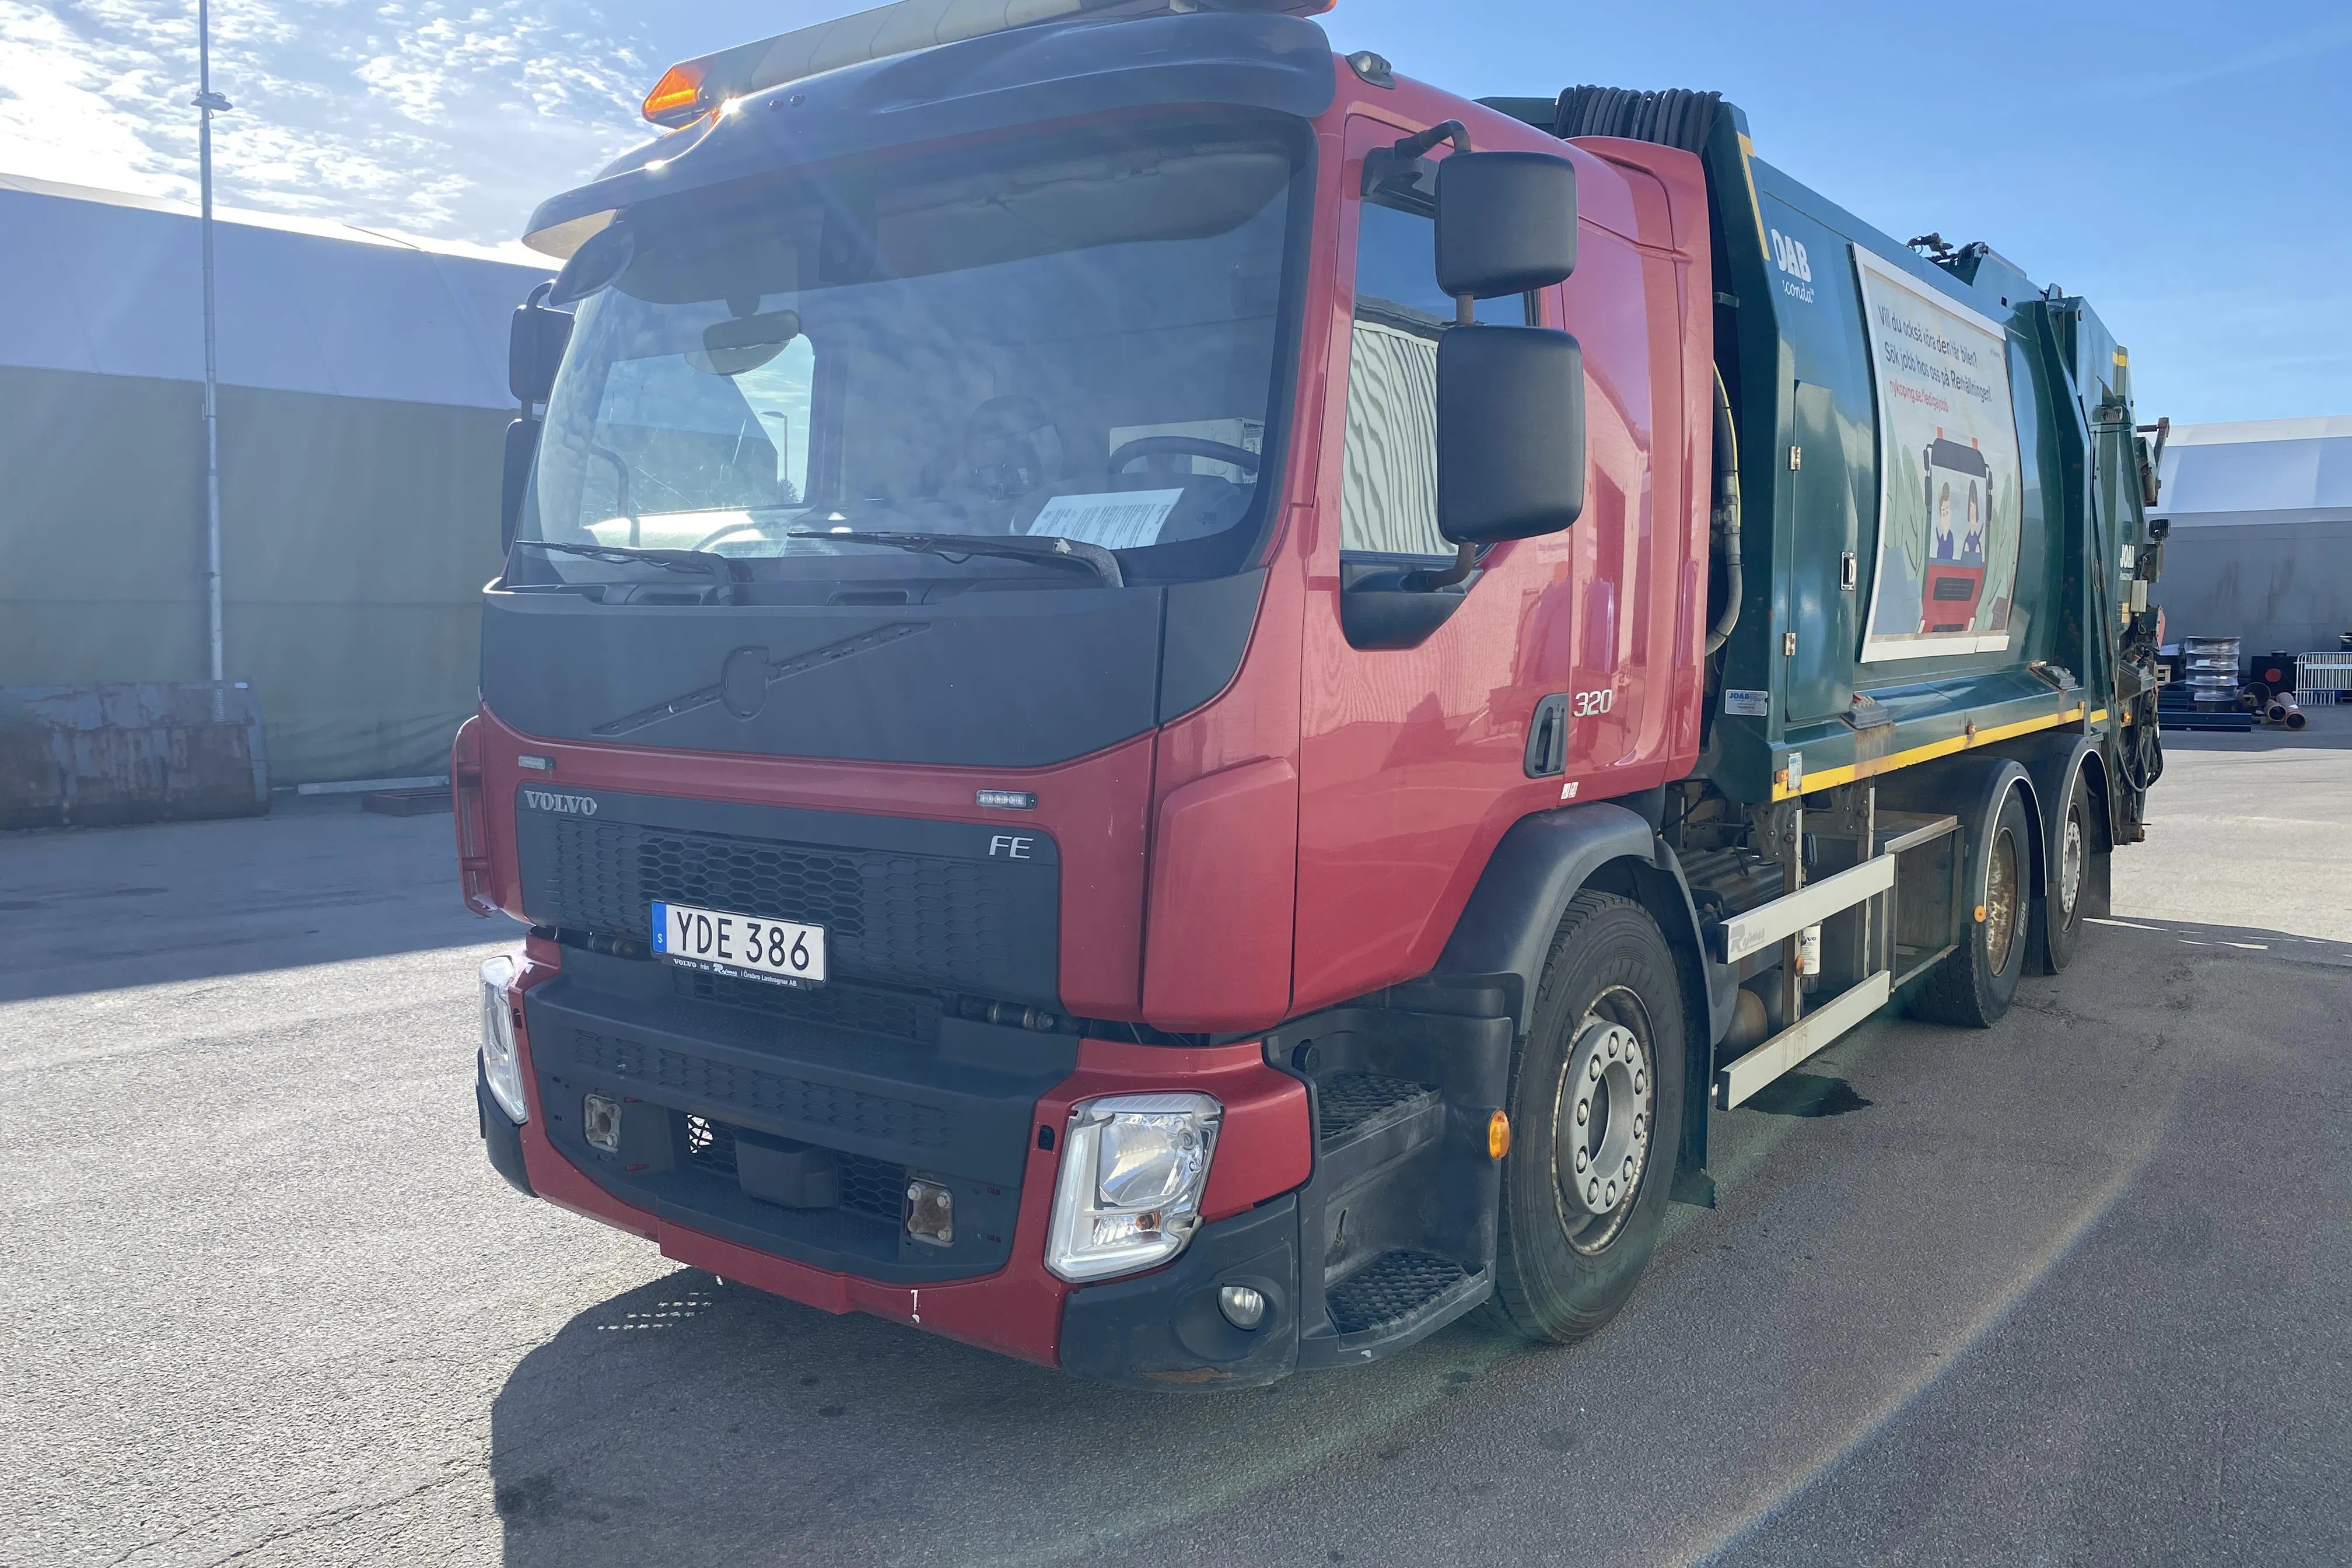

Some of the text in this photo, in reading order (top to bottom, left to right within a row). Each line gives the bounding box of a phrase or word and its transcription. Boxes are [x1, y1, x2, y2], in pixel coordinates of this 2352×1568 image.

[1878, 304, 1891, 329] Vill
[1892, 312, 1902, 333] du
[1903, 319, 1923, 344] också
[1922, 327, 1936, 350] köra
[1937, 334, 1951, 355] den
[1960, 344, 1978, 369] bilen?
[1884, 341, 1900, 366] Sök
[1899, 347, 1916, 373] jobb
[1915, 354, 1930, 378] hos
[1929, 365, 1941, 383] oss
[1941, 366, 1950, 388] på
[1573, 689, 1613, 718] 320
[524, 790, 597, 816] VOLVO
[989, 835, 1034, 859] FE
[657, 911, 810, 971] S YDE 386
[673, 958, 697, 968] VOLVO
[699, 963, 710, 971] från
[743, 970, 761, 980] Örebro
[761, 974, 789, 985] Lastvagnar
